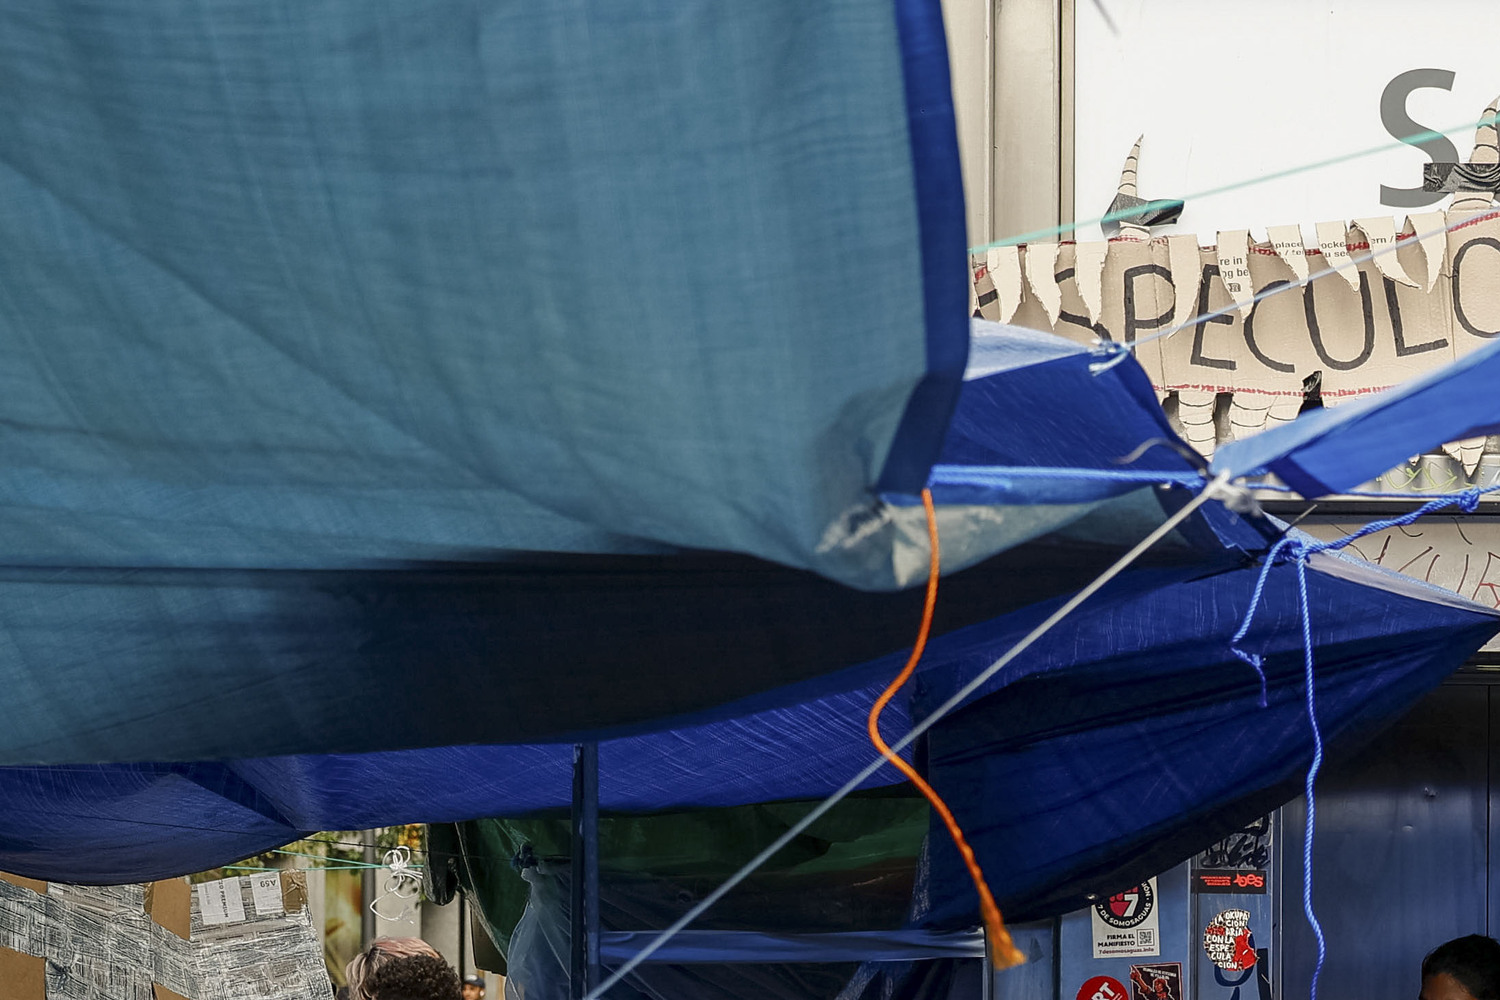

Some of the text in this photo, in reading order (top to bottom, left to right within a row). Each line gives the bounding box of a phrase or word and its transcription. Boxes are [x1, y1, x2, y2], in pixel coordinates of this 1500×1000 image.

[1123, 893, 1139, 918] 7
[1109, 902, 1152, 927] SOMOSAGUAS
[1097, 940, 1136, 948] MANIFIESTO
[1206, 934, 1224, 944] CON
